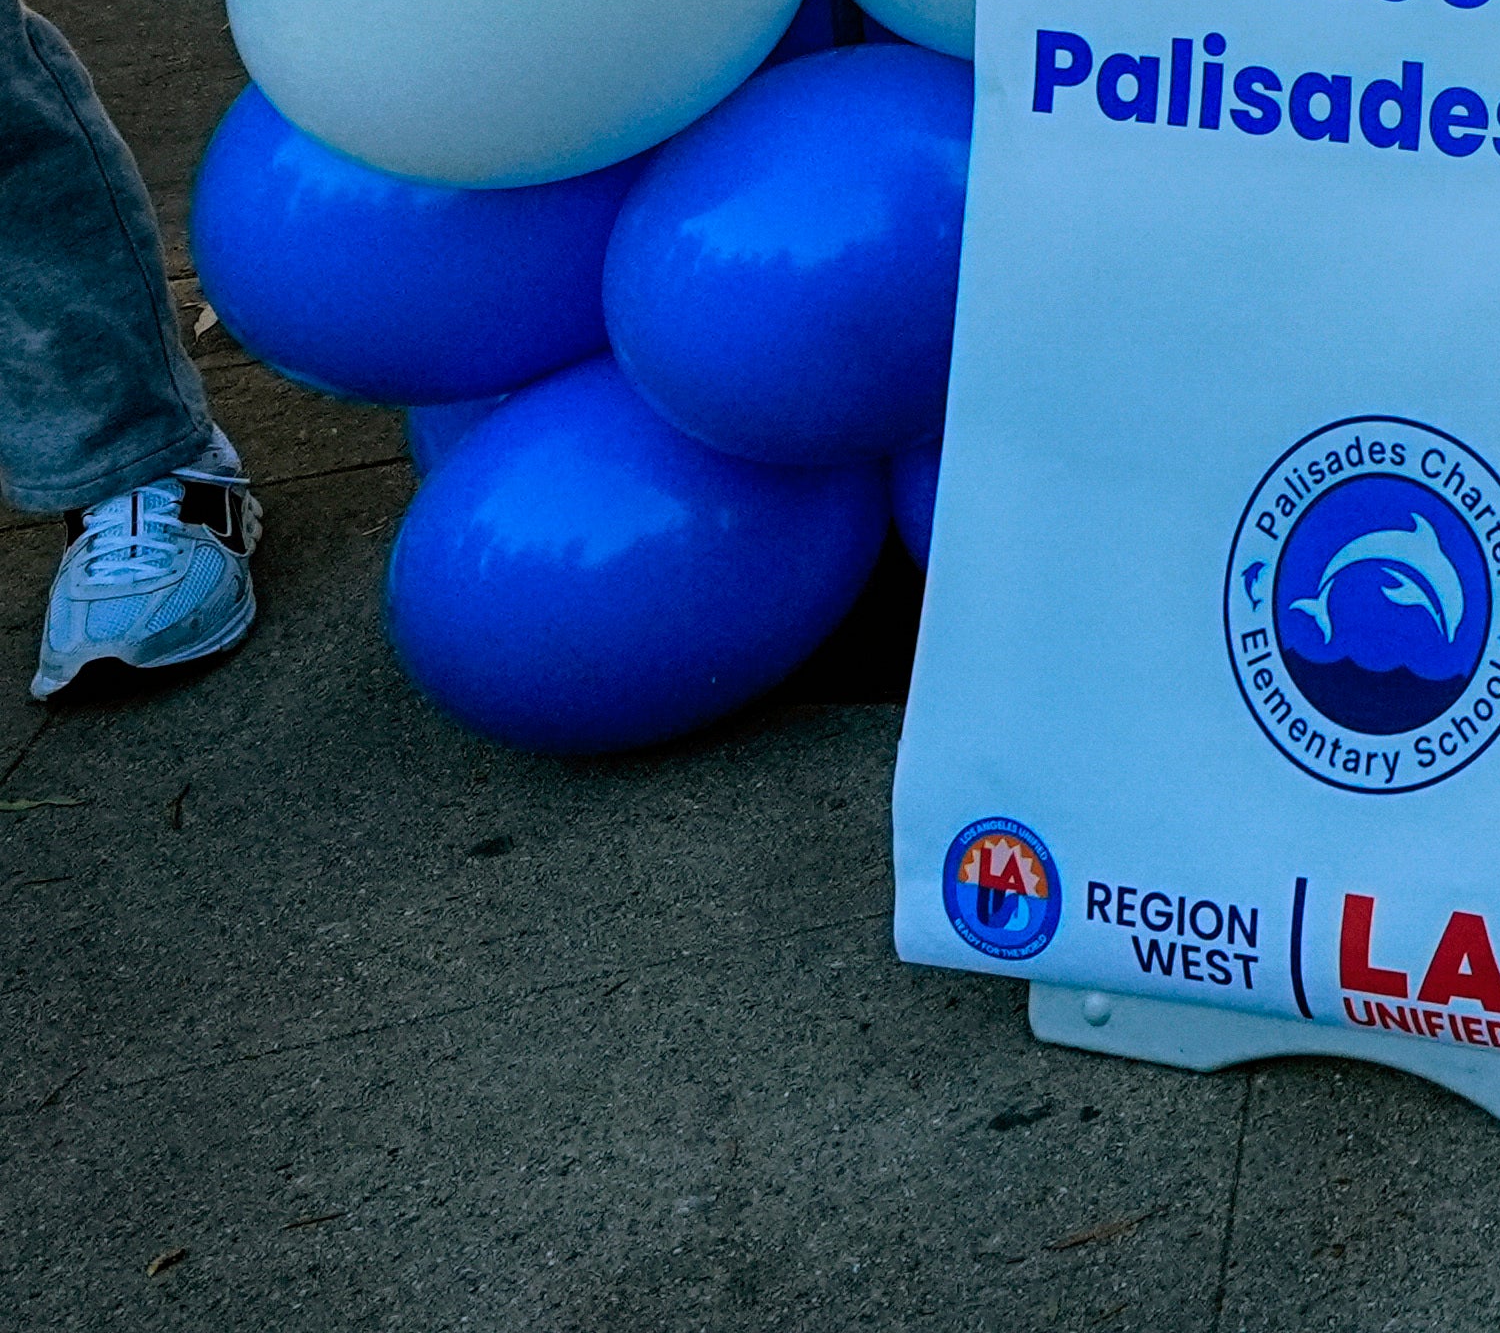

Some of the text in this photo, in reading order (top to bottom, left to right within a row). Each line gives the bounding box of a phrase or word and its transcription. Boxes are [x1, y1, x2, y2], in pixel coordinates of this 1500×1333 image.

[1256, 436, 1406, 540] Palisades
[1241, 628, 1400, 783] Elementary
[960, 821, 1048, 861] LOS ANGELES UNIFIED
[979, 847, 1027, 895] LA
[954, 918, 1047, 957] READY FOR THE WORLD
[1087, 881, 1259, 948] REGION
[1131, 935, 1259, 990] WEST
